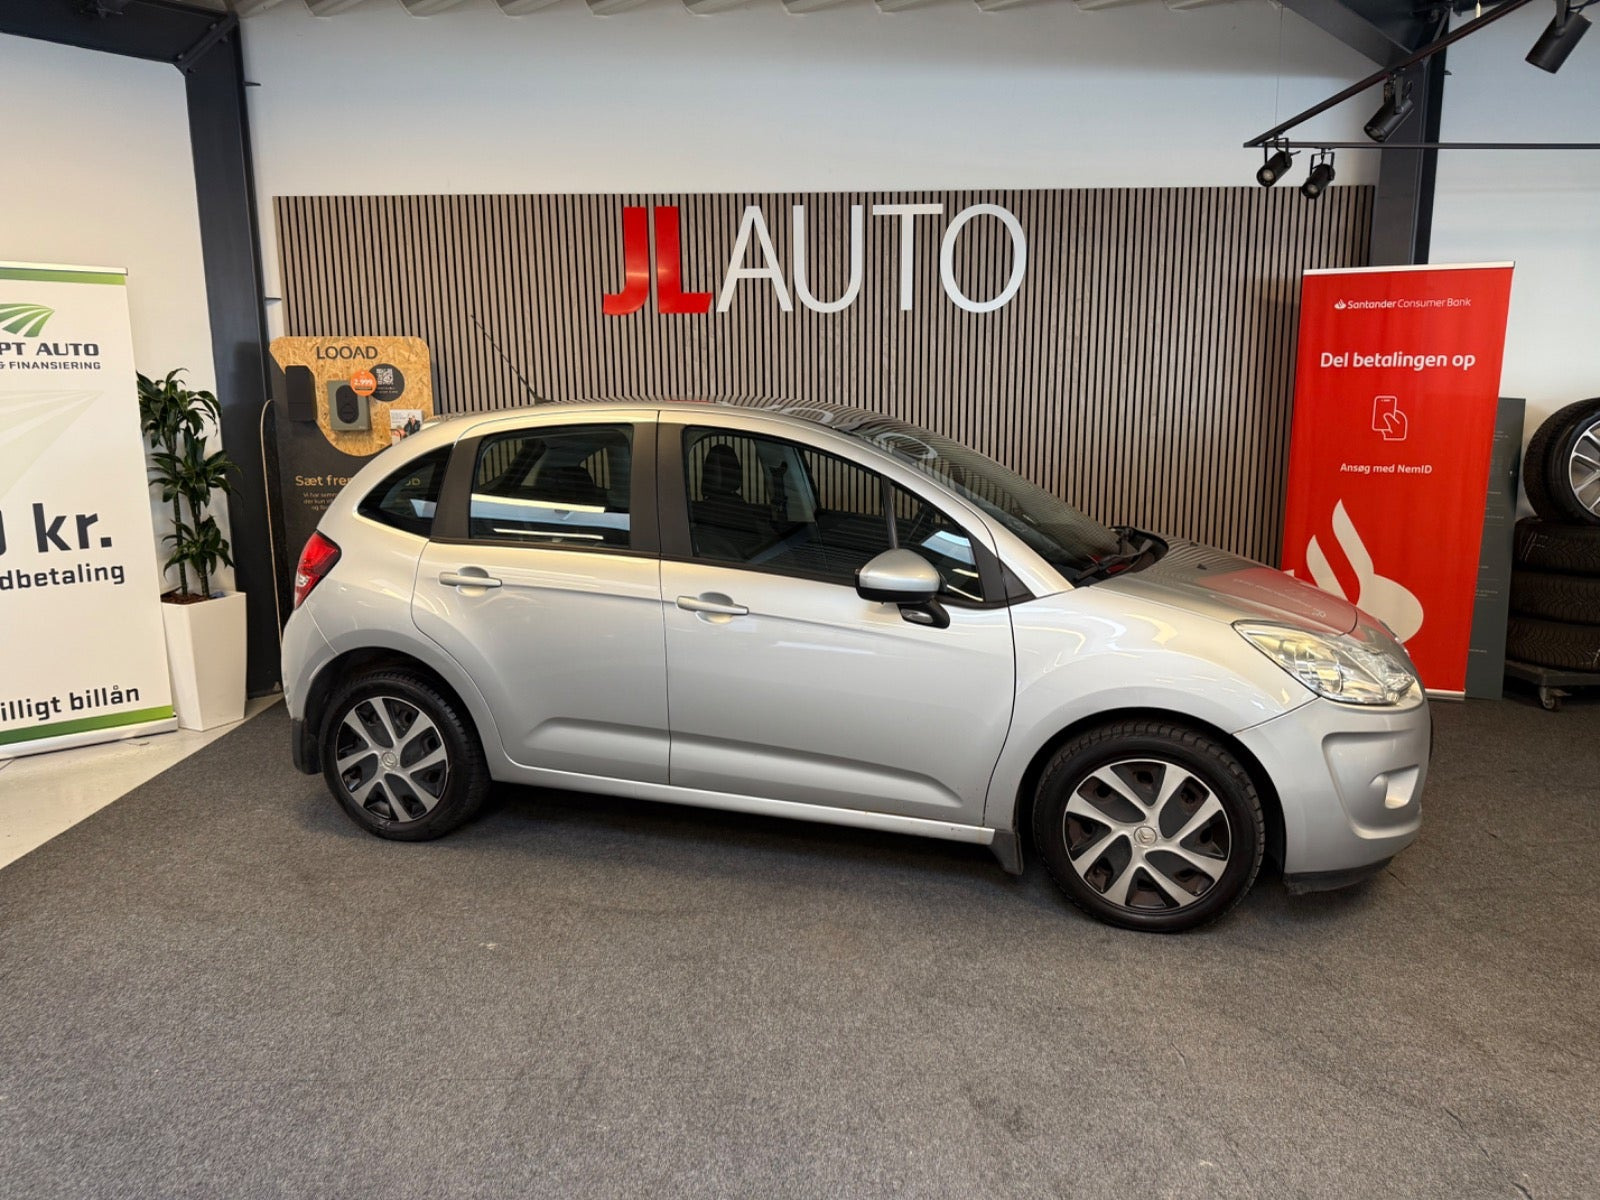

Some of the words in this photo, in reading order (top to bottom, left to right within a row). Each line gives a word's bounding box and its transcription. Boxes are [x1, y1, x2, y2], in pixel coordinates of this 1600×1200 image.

[1347, 299, 1397, 309] Santander
[1397, 298, 1445, 308] Consumer
[1446, 297, 1471, 307] Bank
[36, 342, 99, 356] AUTO
[316, 345, 378, 360] LOOAD
[9, 361, 101, 370] FINANSIERING
[1320, 352, 1348, 368] Del
[1353, 351, 1447, 371] betalingen
[1452, 354, 1476, 371] op
[1340, 463, 1371, 475] Ansøg
[1373, 463, 1395, 474] med
[1397, 463, 1433, 474] NemID
[295, 475, 324, 487] Sæt
[32, 502, 112, 553] kr.
[0, 563, 125, 590] dbetaling
[1, 697, 62, 722] illigt
[69, 684, 140, 711] billån
